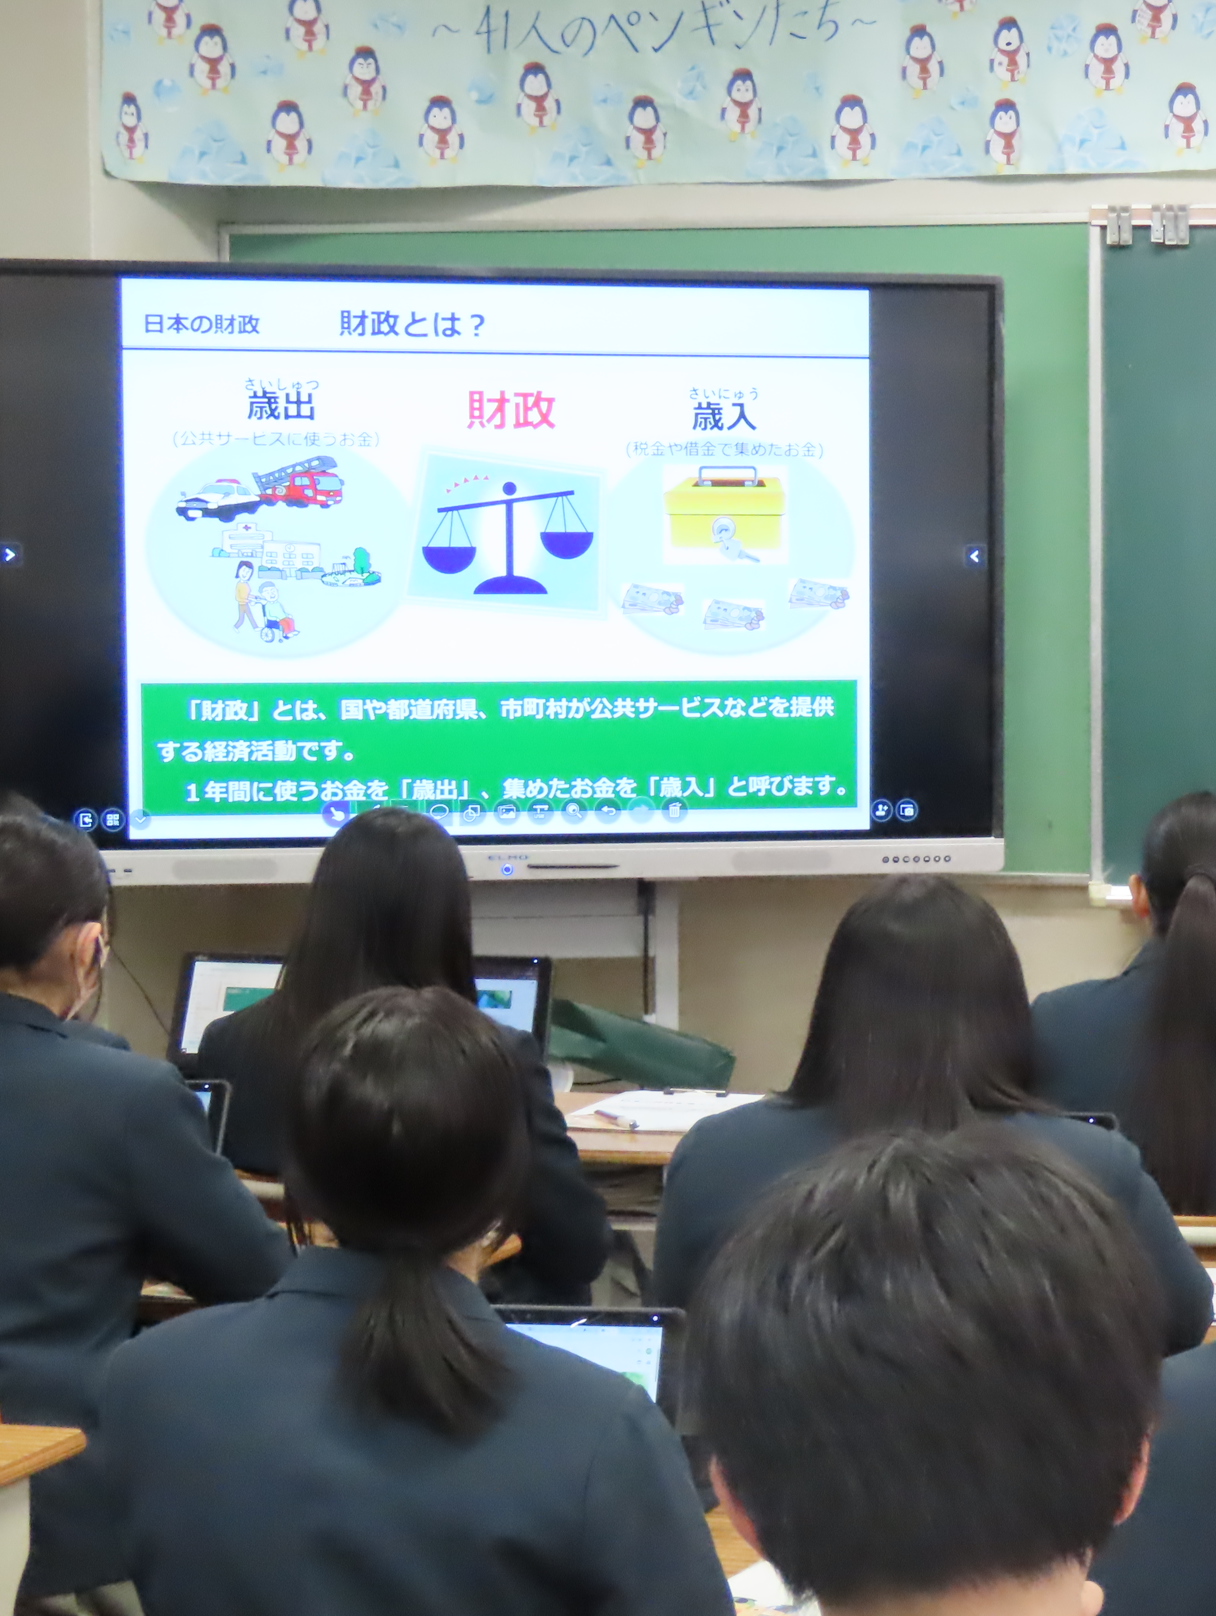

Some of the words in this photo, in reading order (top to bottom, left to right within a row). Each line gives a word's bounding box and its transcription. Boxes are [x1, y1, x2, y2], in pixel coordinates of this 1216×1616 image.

[144, 313, 261, 334] 日本の財政
[339, 309, 486, 338] 財政とは？
[244, 377, 319, 391] さいしゅつ
[689, 386, 759, 401] さいにゅう
[247, 389, 316, 421] 歳出
[467, 390, 556, 430] 財政
[692, 401, 758, 431] 歳入
[189, 696, 835, 722] 「財政」とは、国や都道府県、市町村が公共サービスなどを提供
[157, 739, 354, 764] する経済活動です。
